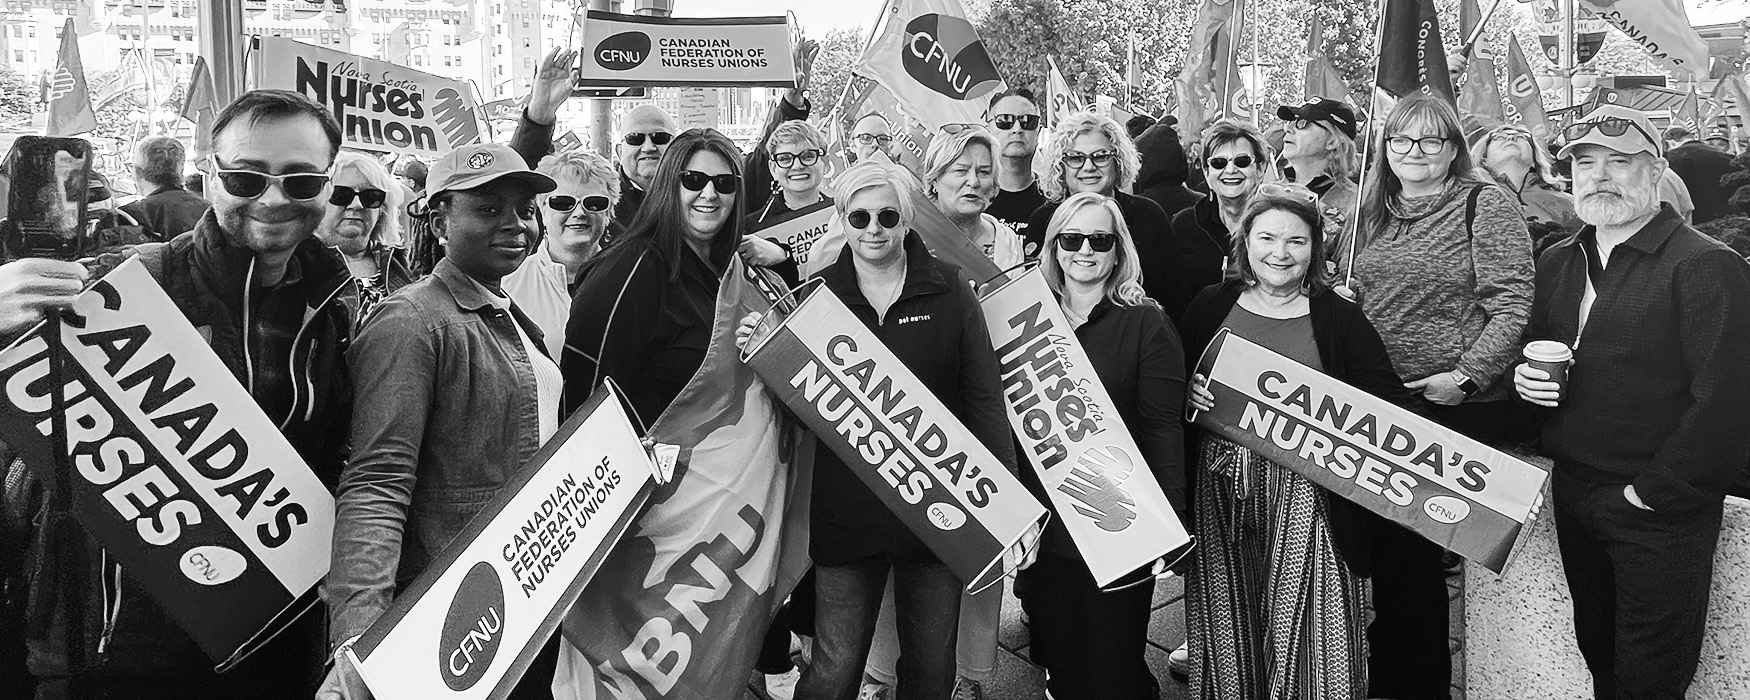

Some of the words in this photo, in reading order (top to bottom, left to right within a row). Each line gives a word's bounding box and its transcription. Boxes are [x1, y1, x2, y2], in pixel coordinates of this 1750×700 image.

[332, 61, 371, 81] Nova
[381, 71, 419, 93] Scotia
[599, 49, 641, 64] CFNU
[658, 38, 731, 49] CANADIAN
[660, 48, 745, 58] FEDERATION
[747, 48, 766, 57] OF
[661, 57, 715, 68] NURSES
[717, 57, 768, 68] UNIONS
[910, 31, 972, 94] CFNU
[890, 121, 924, 158] Union
[60, 279, 308, 549] CANADA'S
[1047, 333, 1074, 370] Nova
[1073, 377, 1105, 423] Scotia
[789, 358, 934, 505] NURSES
[826, 333, 1000, 509] CANADA'S
[1237, 399, 1420, 507] NURSES
[1256, 369, 1493, 494] CANADA'S
[502, 473, 577, 562] CANADIAN
[510, 476, 594, 582] FEDERATION
[594, 455, 612, 482] OF
[520, 525, 577, 599] NURSES
[576, 469, 622, 529] UNIONS
[931, 507, 953, 529] CFNU
[1428, 502, 1457, 522] CFNU
[448, 606, 502, 678] CFNU
